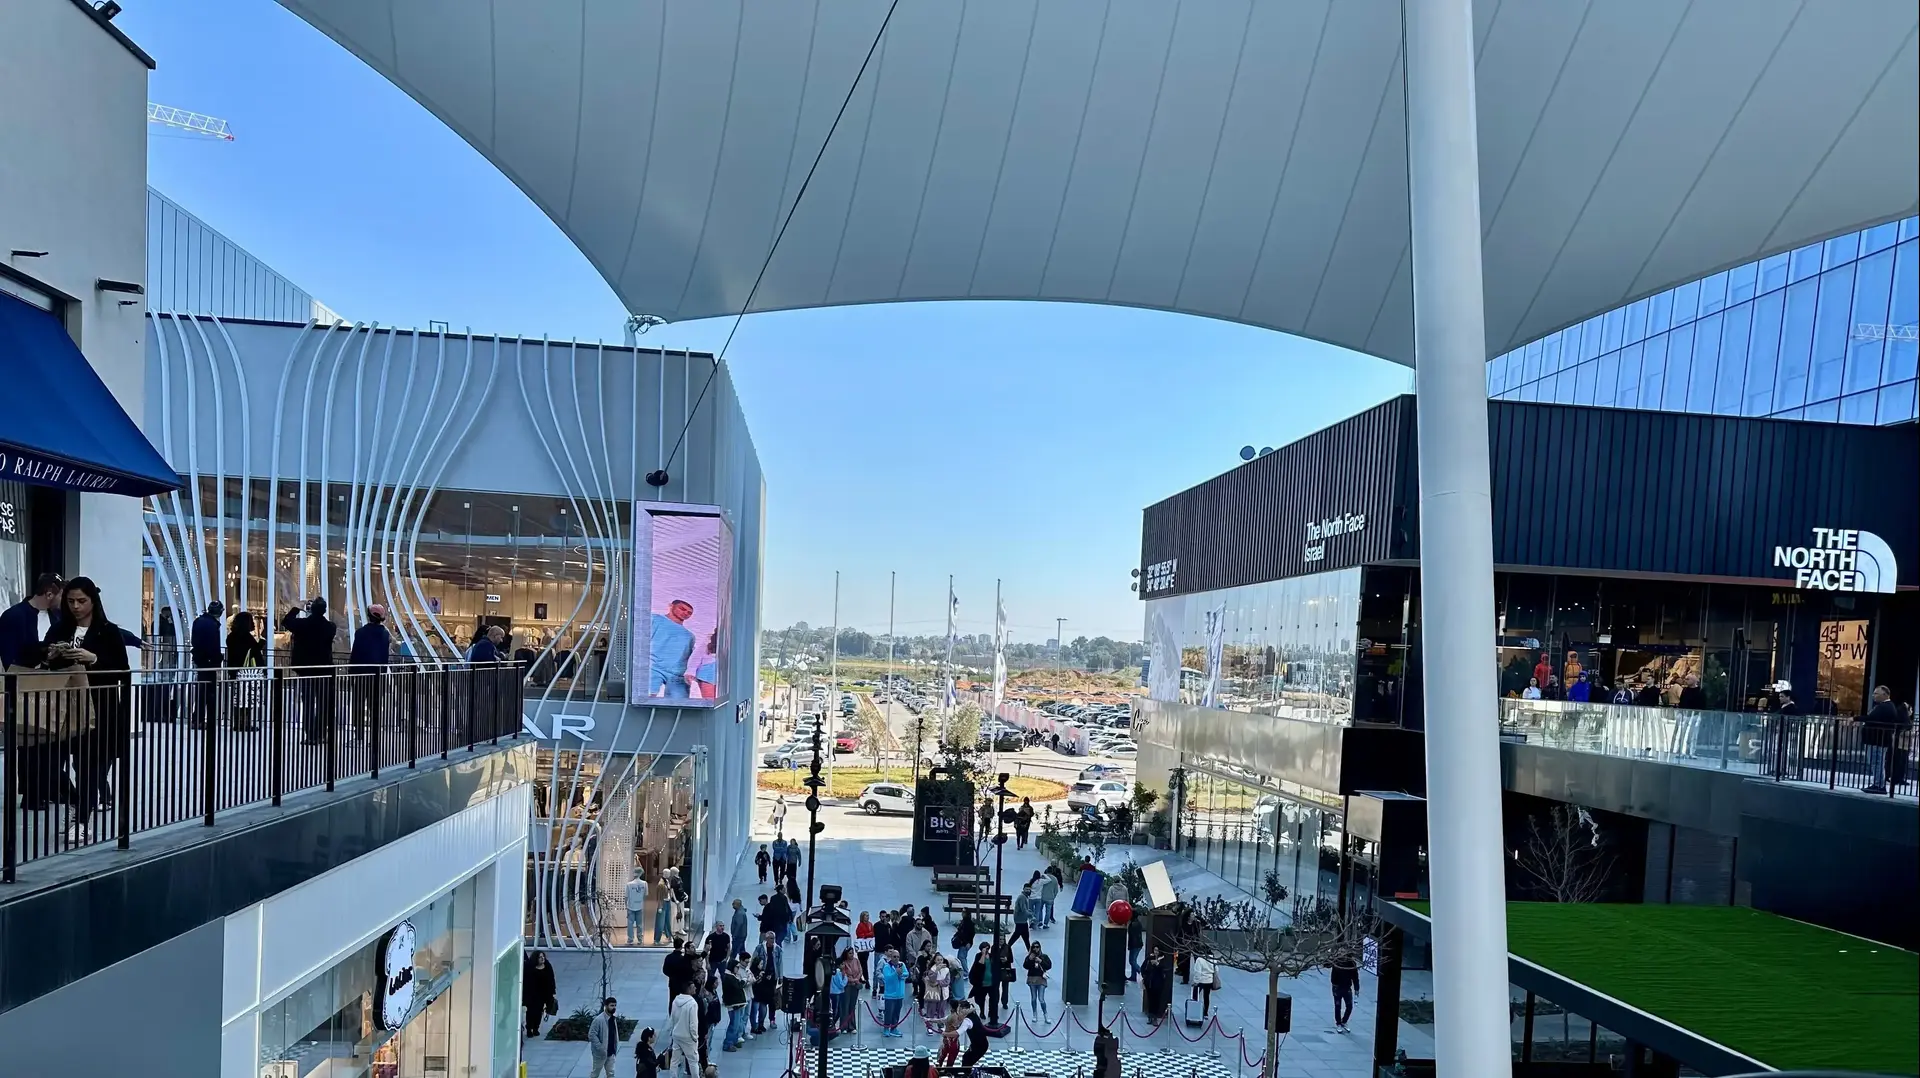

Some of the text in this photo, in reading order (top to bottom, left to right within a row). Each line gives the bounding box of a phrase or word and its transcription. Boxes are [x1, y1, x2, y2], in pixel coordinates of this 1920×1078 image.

[14, 456, 64, 482] RALPH
[1307, 512, 1365, 541] The North Face
[1812, 527, 1858, 549] THE
[1304, 540, 1325, 562] Israel
[1773, 546, 1856, 570] NORTH
[1795, 569, 1855, 591] FACE
[1850, 643, 1867, 660] W
[930, 816, 955, 828] BIG
